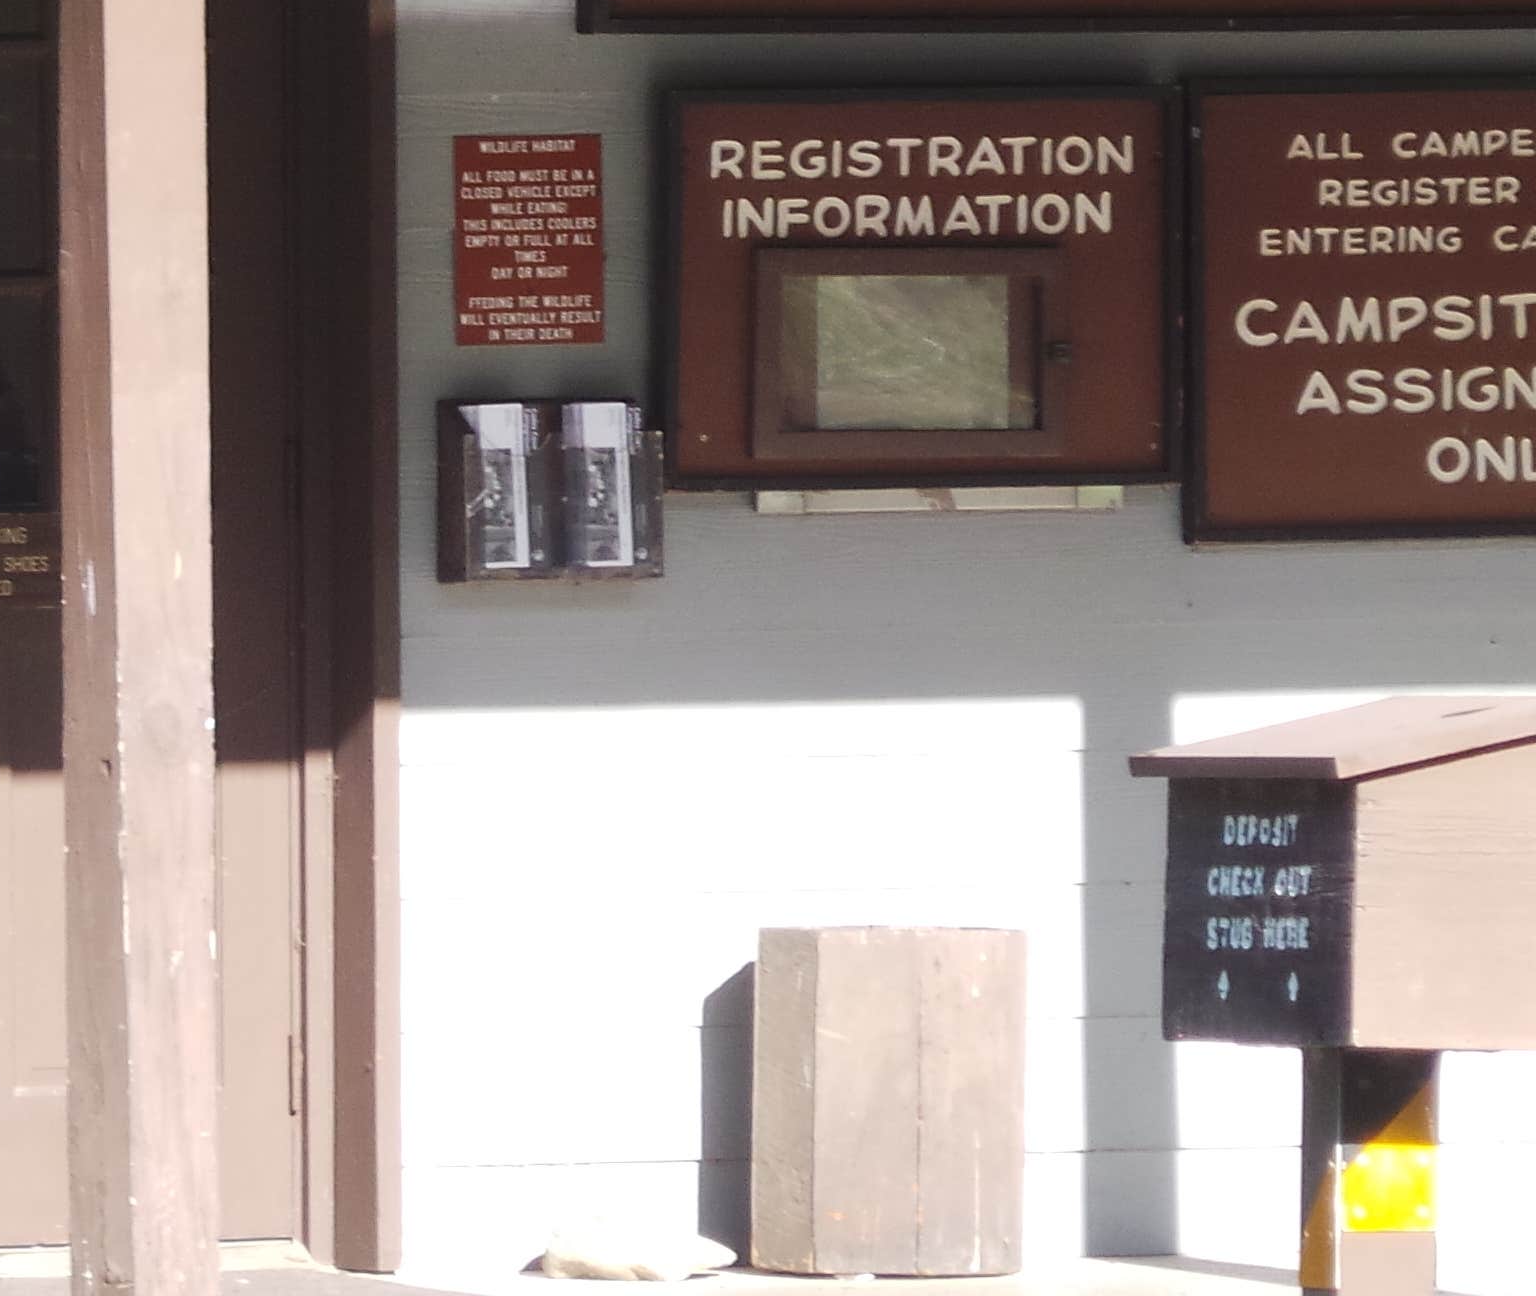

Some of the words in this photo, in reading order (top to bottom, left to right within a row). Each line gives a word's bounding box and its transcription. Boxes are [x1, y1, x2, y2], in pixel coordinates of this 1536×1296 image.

[479, 140, 529, 153] WILDLIFE
[531, 140, 576, 152] HABITAT
[1286, 133, 1365, 161] ALL
[709, 135, 1135, 181] REGISTRATION
[462, 171, 483, 183] ALL
[486, 170, 515, 182] FOOD
[520, 170, 549, 182] MUST
[553, 170, 568, 181] BE
[587, 170, 594, 181] A
[461, 187, 503, 199] CLOSED
[508, 186, 551, 198] VEHICLE
[556, 185, 597, 197] EXCEPT
[1318, 176, 1522, 208] REGISTER
[491, 203, 523, 214] WHILE
[722, 191, 1113, 240] INFORMATION
[463, 220, 487, 231] THIS
[491, 218, 544, 231] INCLUDES
[548, 218, 597, 229] COOLERS
[465, 236, 501, 248] EMPTY
[504, 235, 520, 247] OR
[524, 235, 552, 246] FULL
[555, 235, 569, 246] AT
[573, 234, 594, 245] ALL
[1259, 226, 1464, 257] ENTERING
[515, 251, 548, 263] TIMES
[491, 268, 513, 279] DAY
[518, 267, 533, 279] OR
[536, 266, 568, 278] NIGHT
[469, 296, 514, 308] FEEDING
[518, 296, 539, 308] THE
[543, 295, 592, 307] WILDLIFE
[460, 313, 486, 325] WILL
[490, 312, 557, 324] EVENTUALLY
[561, 311, 602, 323] RESULT
[488, 330, 501, 341] IN
[504, 329, 537, 340] THEIR
[539, 329, 574, 340] DEATH
[3, 556, 49, 572] SHOES
[1223, 814, 1299, 846] DEPOSIT
[1207, 865, 1265, 897] CHECK
[1274, 866, 1312, 897] OUT
[1206, 917, 1254, 950] STUB
[1263, 917, 1310, 950] HERE
